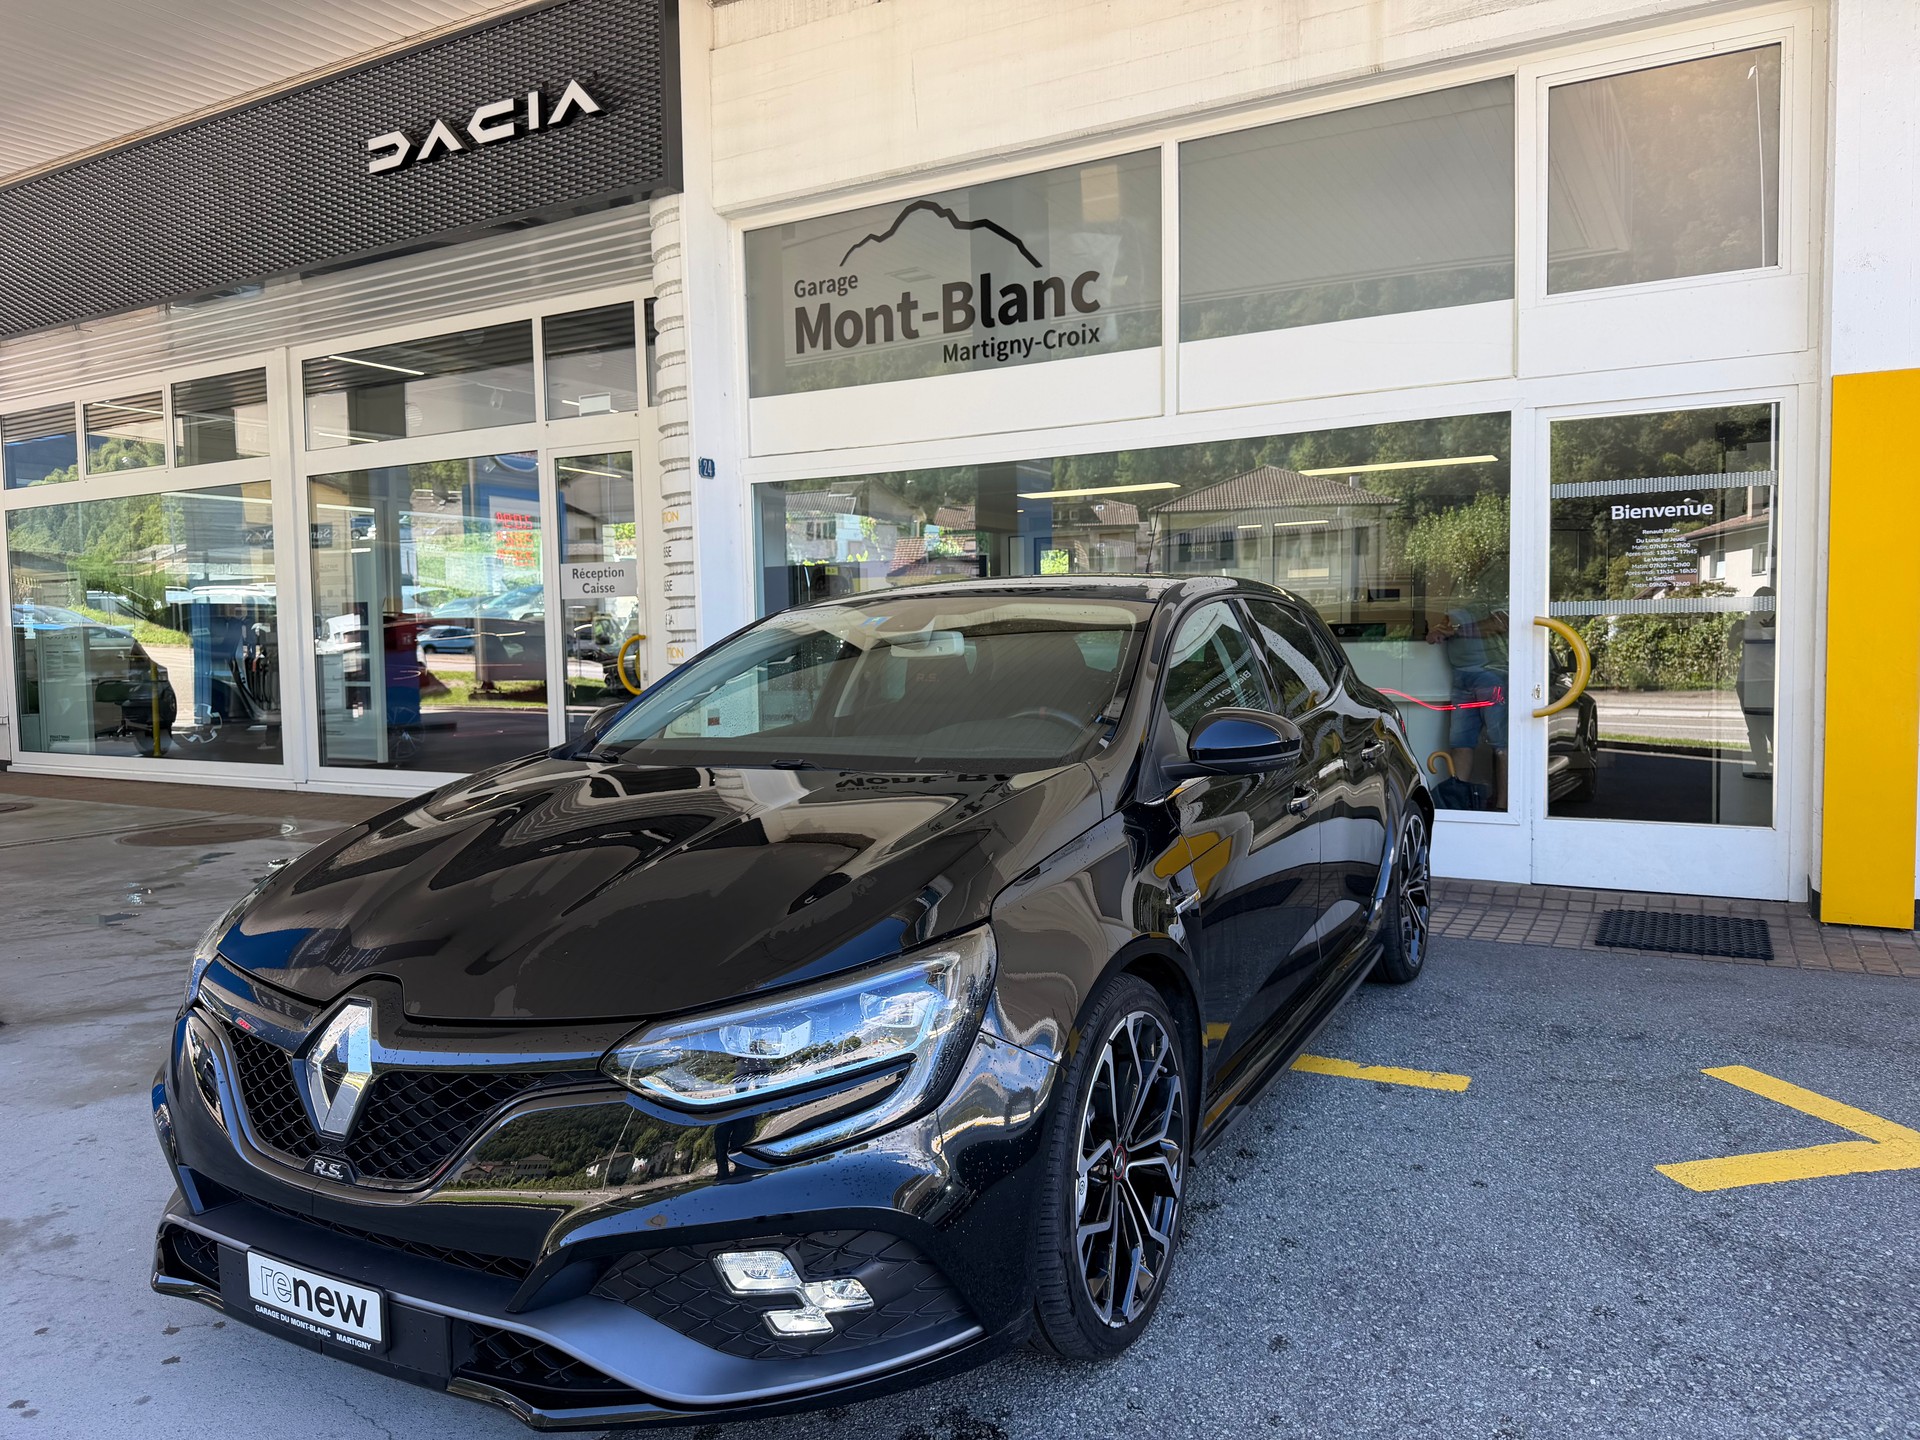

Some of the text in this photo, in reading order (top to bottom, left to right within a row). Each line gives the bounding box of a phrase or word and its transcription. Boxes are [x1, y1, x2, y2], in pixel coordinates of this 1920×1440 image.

[368, 79, 601, 174] DACIA
[794, 274, 858, 299] Garage
[795, 270, 1101, 355] Mont-Blanc
[943, 323, 1100, 363] Martigny-Croix
[703, 459, 713, 477] 24
[1611, 503, 1714, 520] Bienvenue
[572, 566, 624, 581] Réception
[582, 582, 615, 594] Caisse
[261, 1265, 367, 1328] renew
[255, 1304, 372, 1351] GARAGE DU MONT-BLANC MARTIGNY
